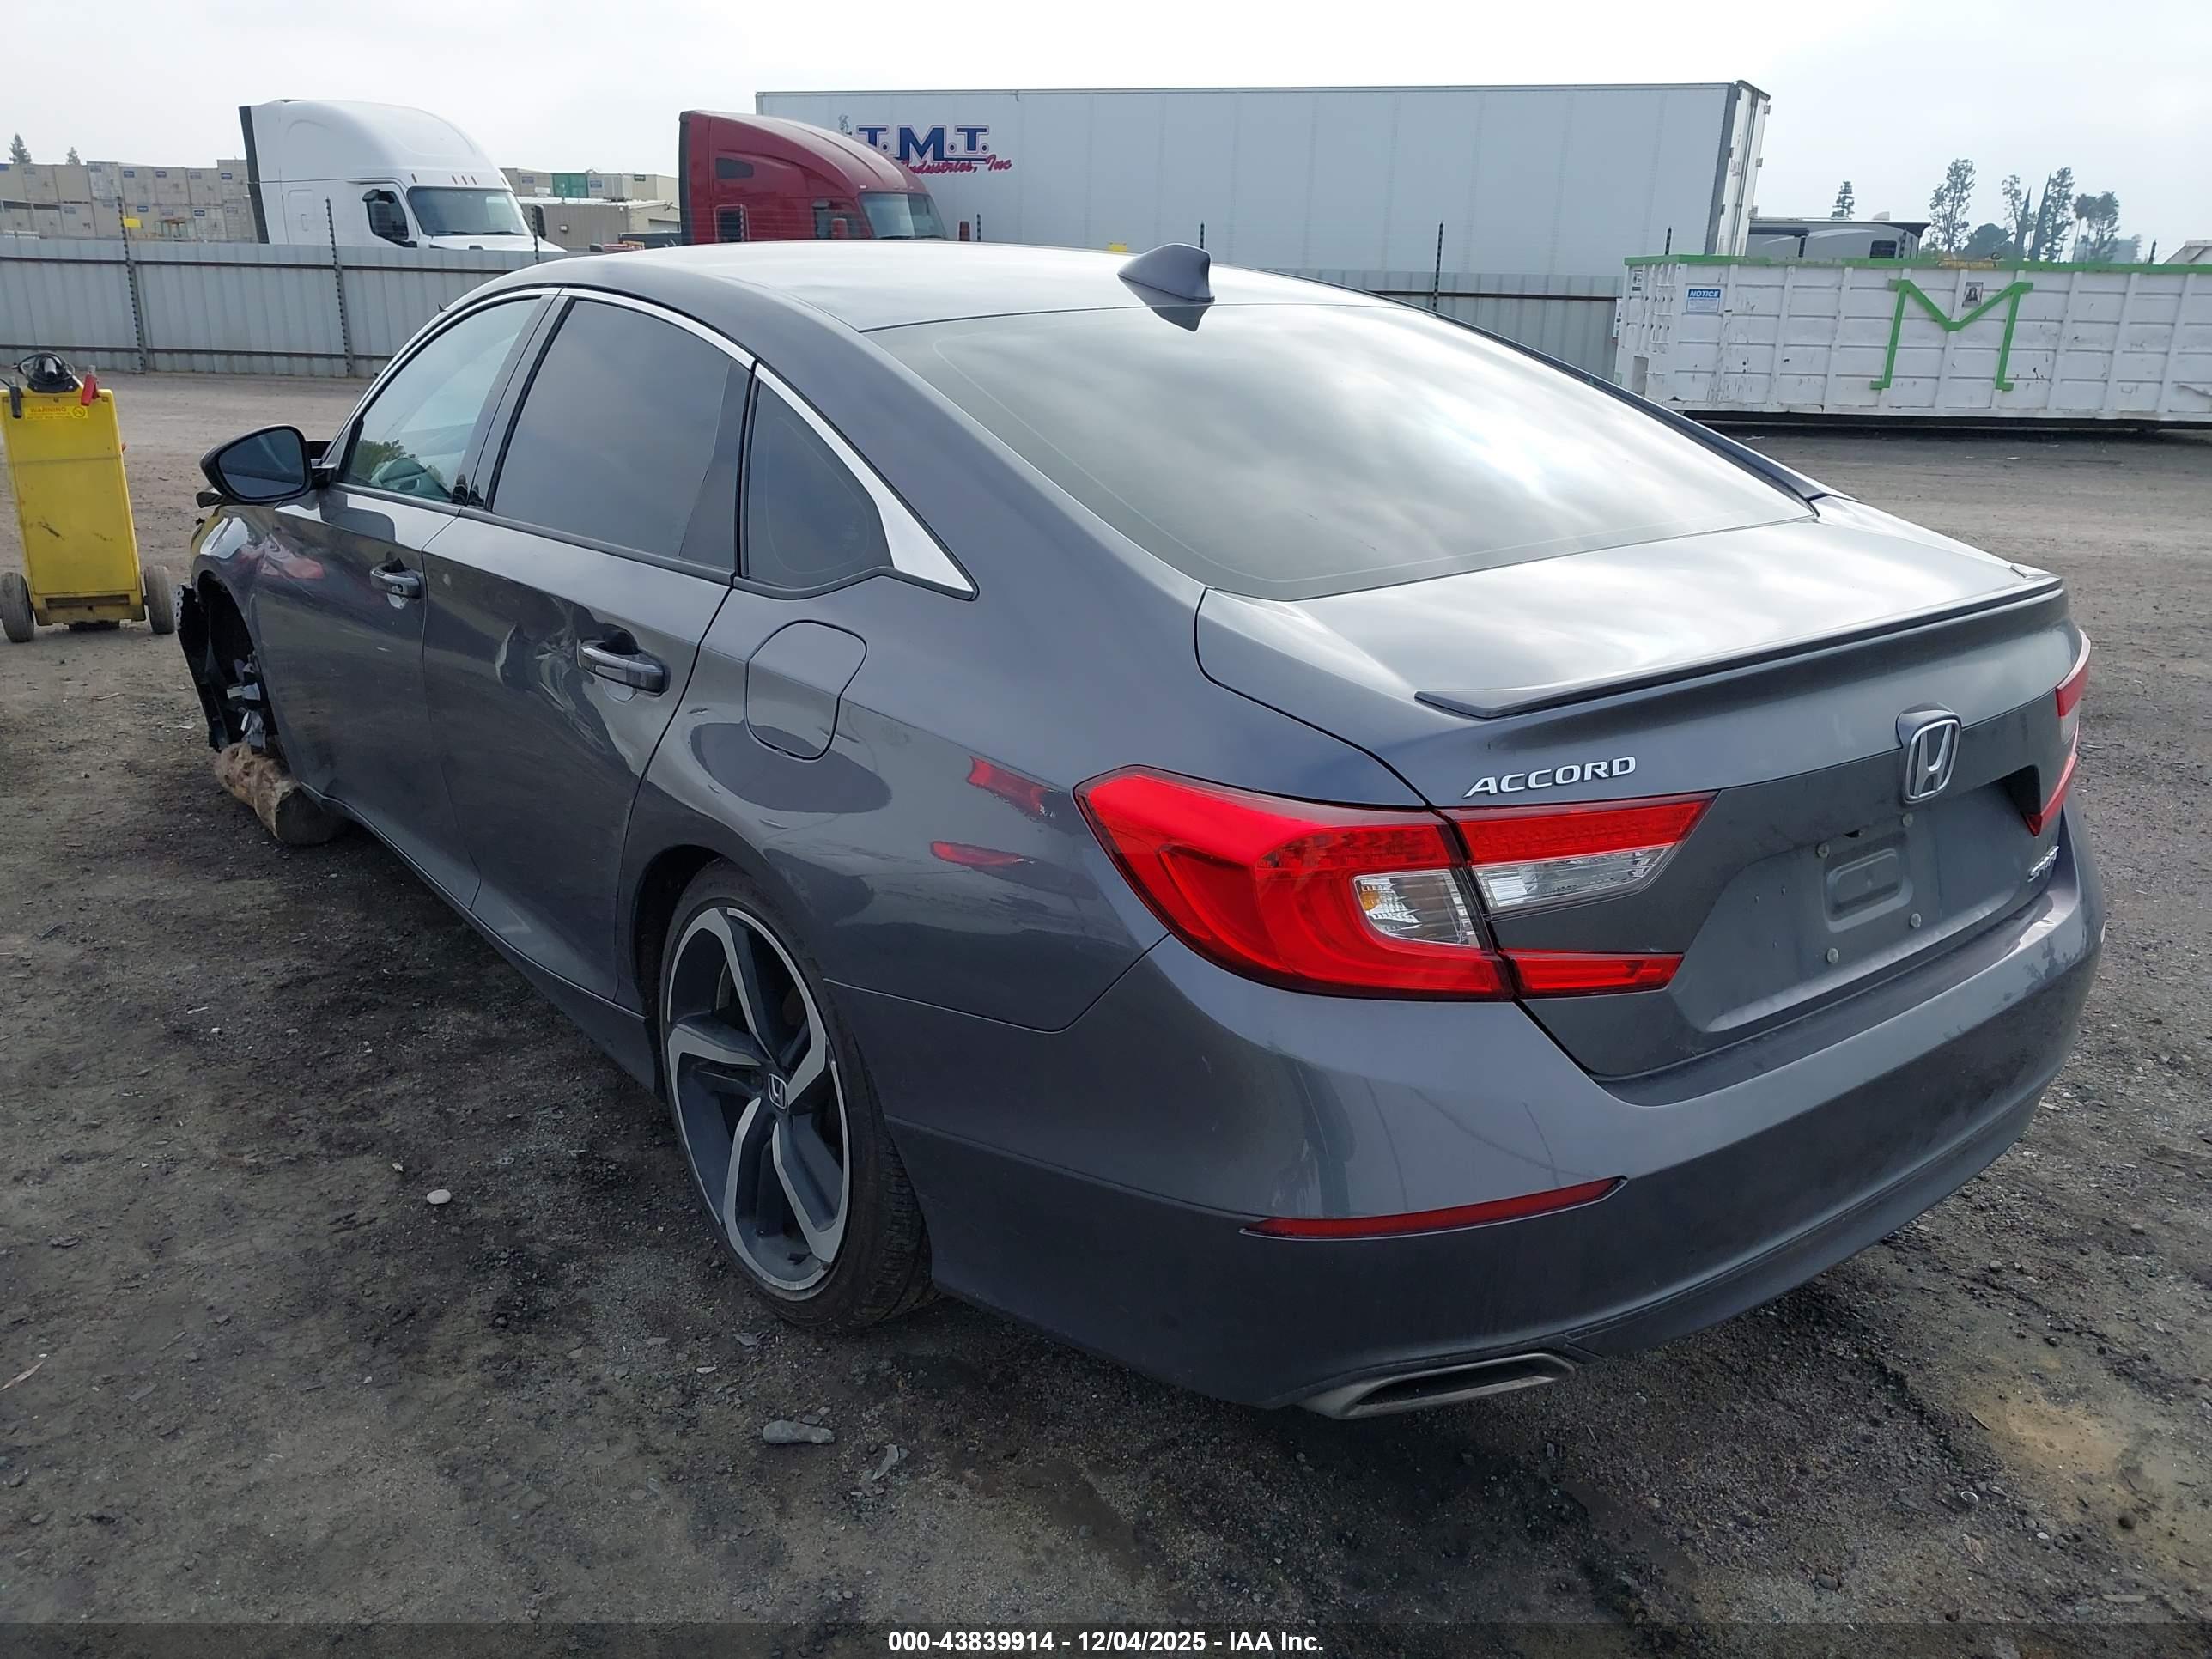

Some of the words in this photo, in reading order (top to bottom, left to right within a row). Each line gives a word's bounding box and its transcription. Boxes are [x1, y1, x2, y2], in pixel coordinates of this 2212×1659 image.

[857, 125, 989, 161] T.M.T.
[985, 154, 1012, 171] Inc
[1462, 756, 1637, 799] ACCORD
